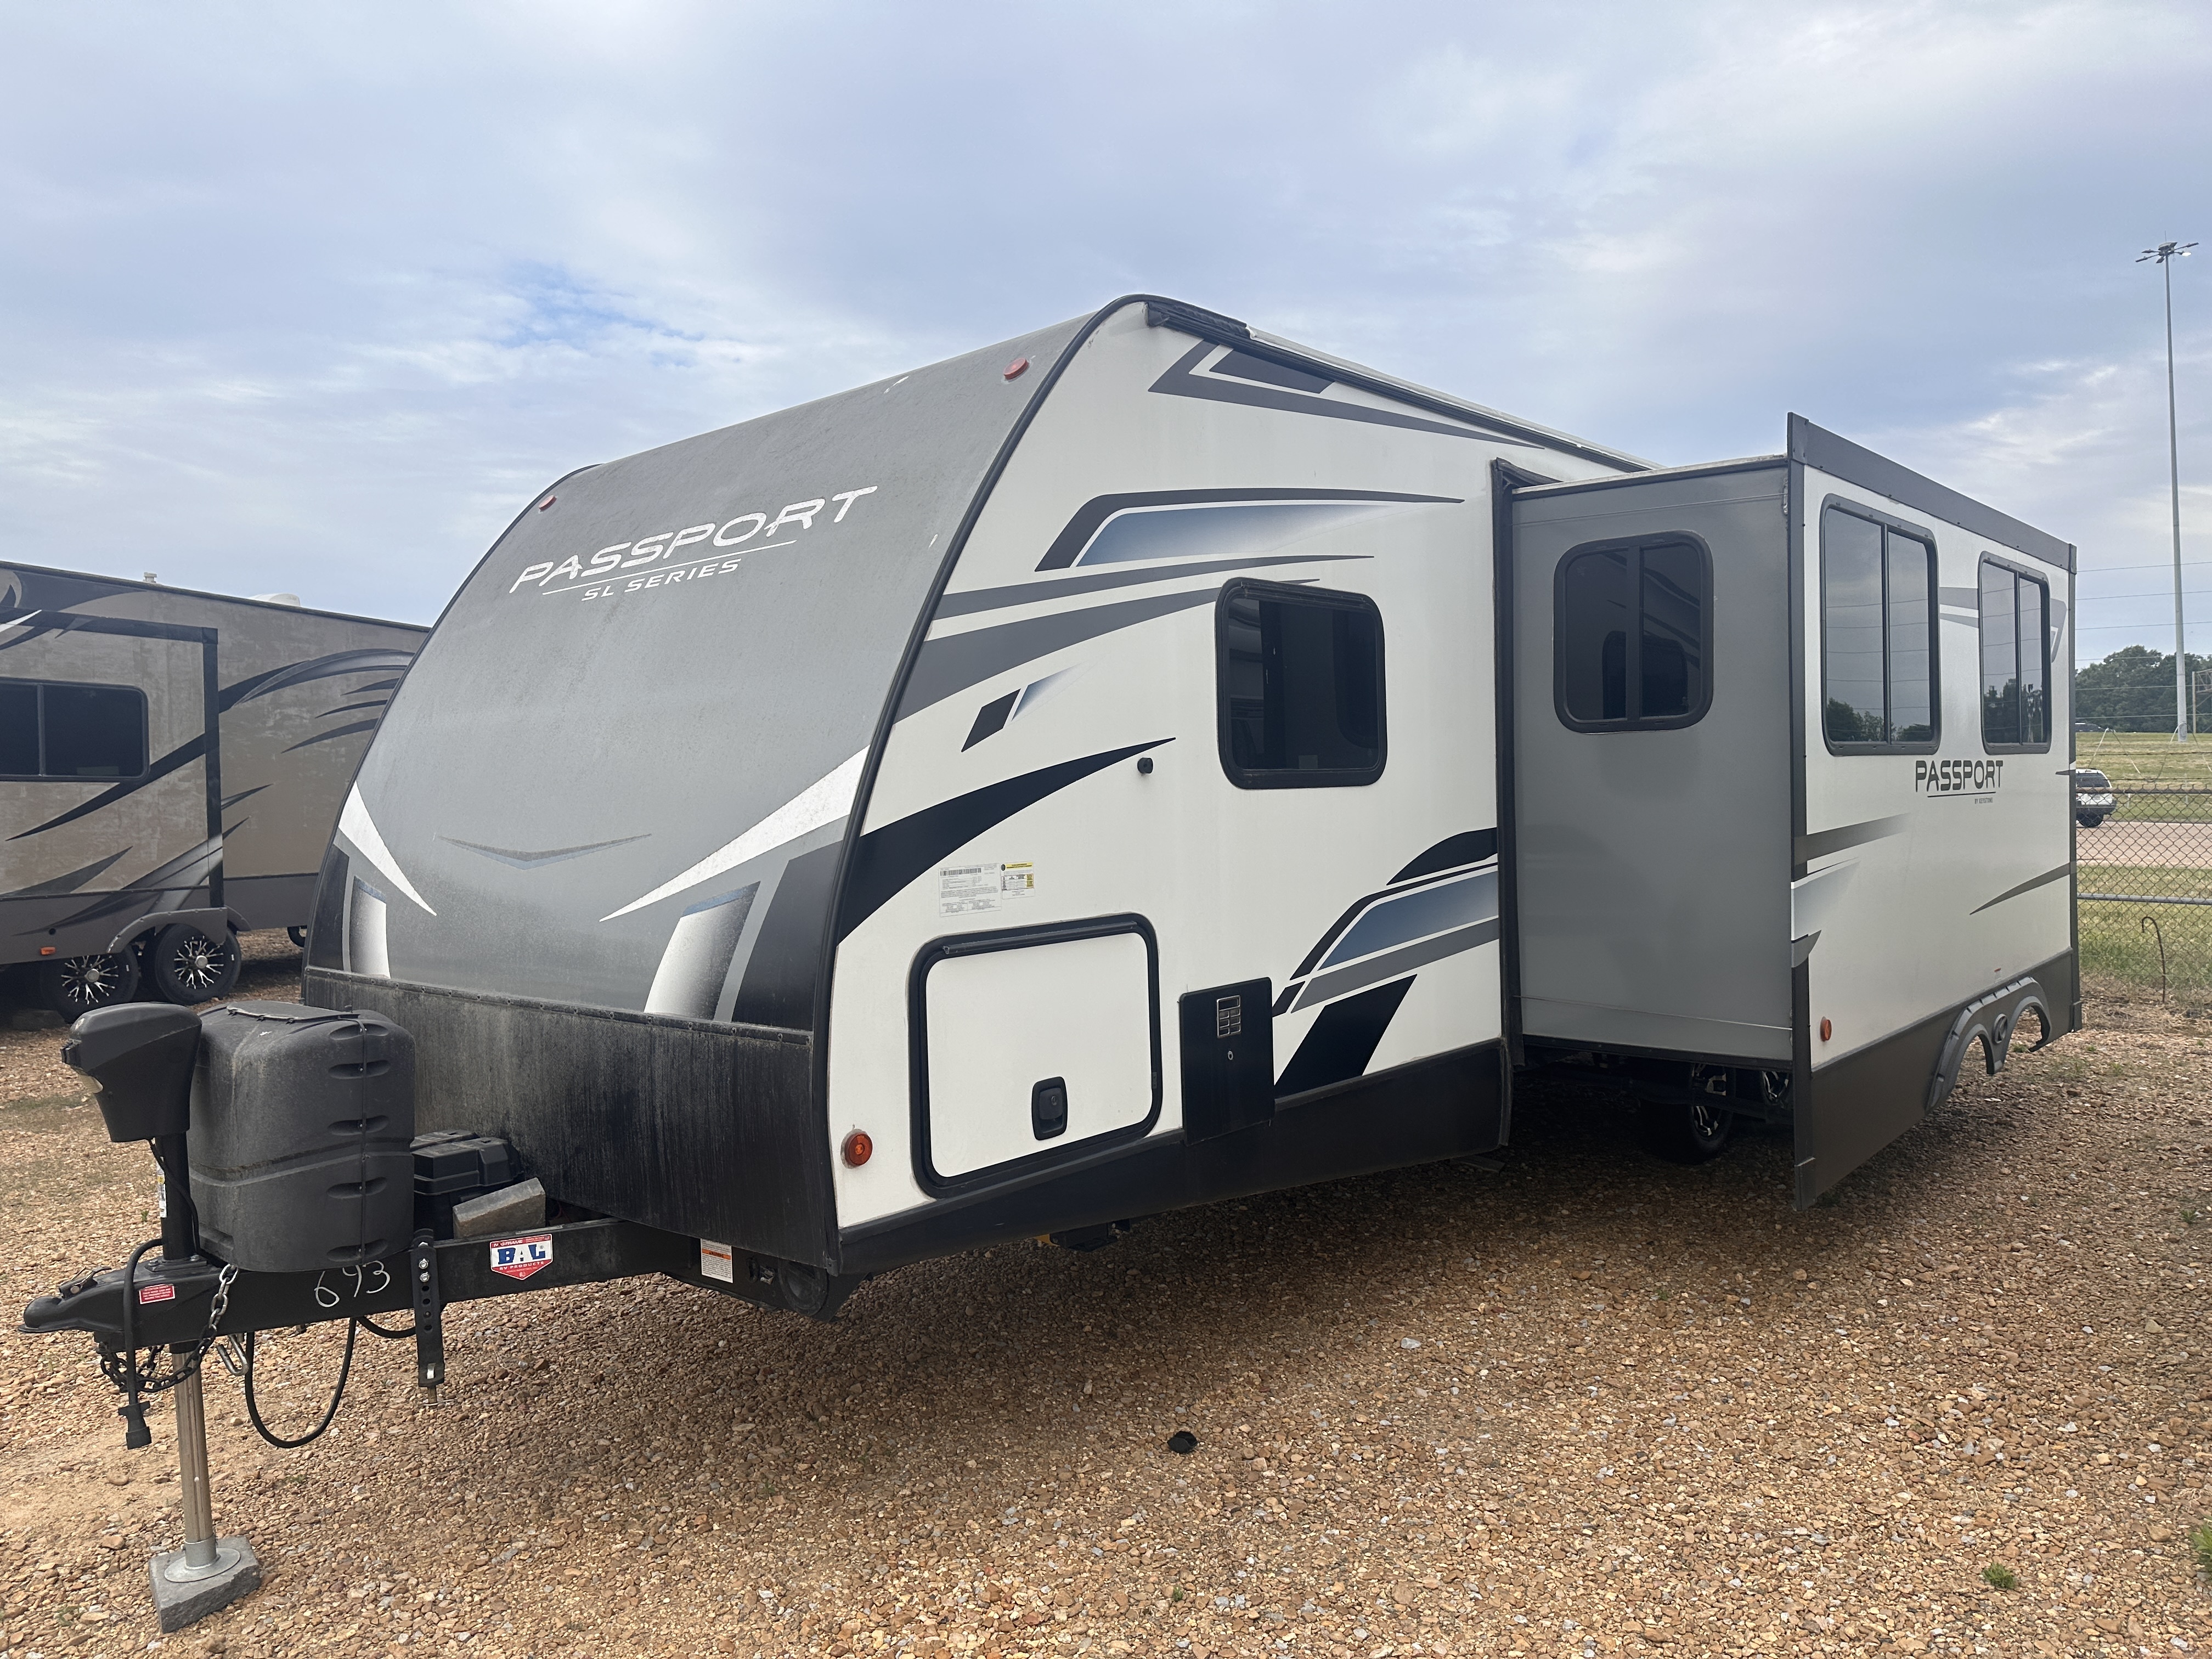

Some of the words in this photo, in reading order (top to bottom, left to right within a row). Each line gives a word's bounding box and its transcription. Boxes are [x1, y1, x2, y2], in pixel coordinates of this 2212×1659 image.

[509, 486, 878, 593] PASSPORT
[582, 585, 614, 601] SL
[624, 558, 742, 593] SERIES
[1916, 760, 2004, 792] PASSPORT
[498, 1244, 545, 1265] BAL
[510, 1261, 544, 1269] PRODUCTS
